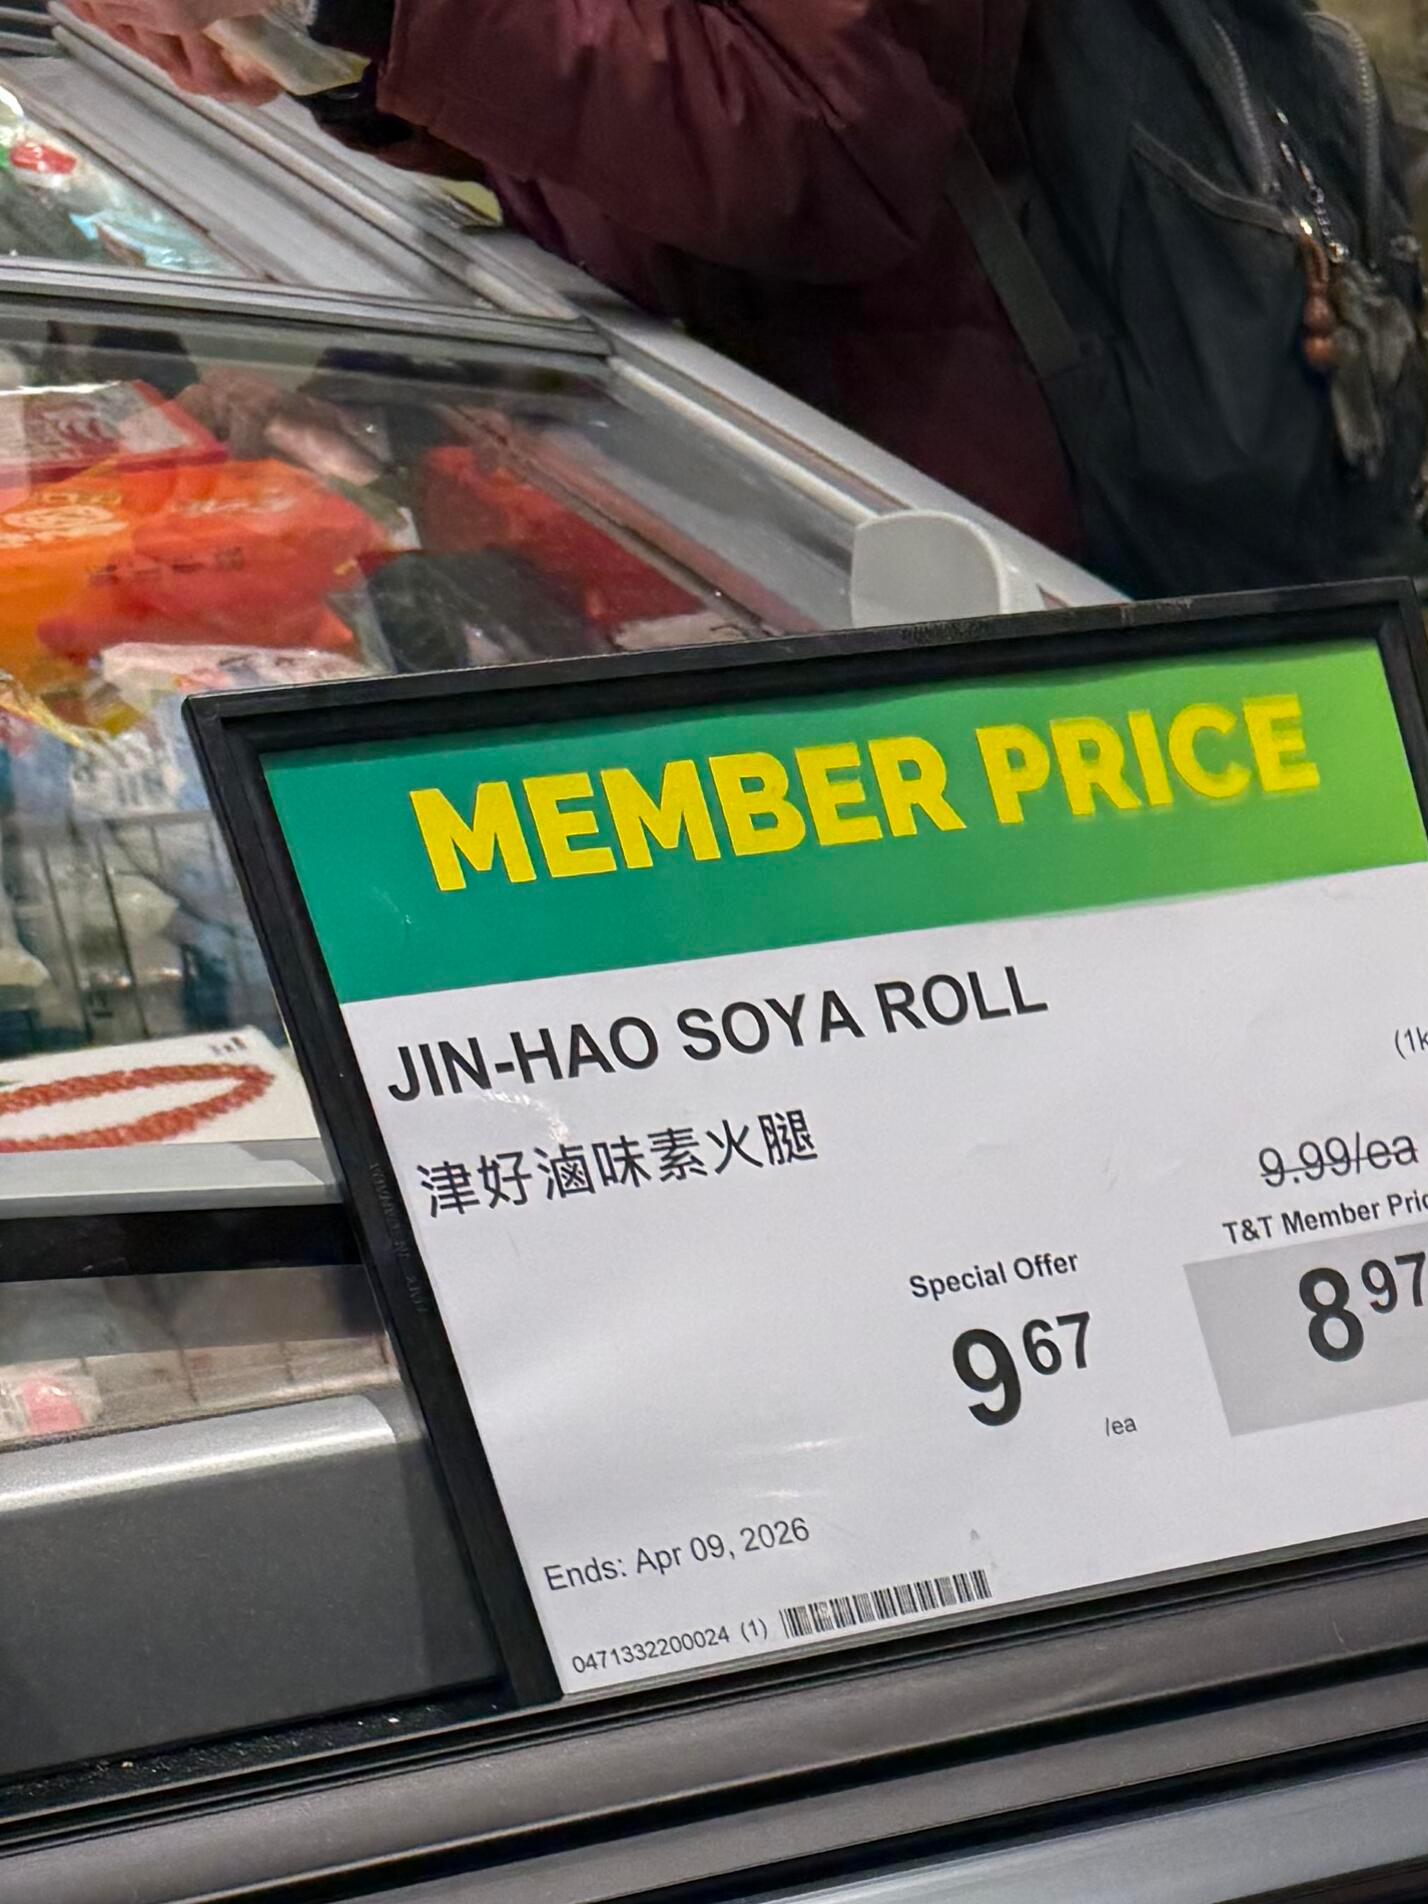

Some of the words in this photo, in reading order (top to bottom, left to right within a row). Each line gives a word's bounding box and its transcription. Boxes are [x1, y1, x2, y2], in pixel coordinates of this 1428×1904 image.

[406, 731, 968, 894] MEMBER
[972, 691, 1322, 827] PRICE
[375, 1011, 666, 1105] JIN-HAO
[671, 984, 868, 1064] SOYA
[873, 960, 1051, 1035] ROLL
[413, 1106, 822, 1220] 津好滷味素火腿
[1254, 1123, 1421, 1190] 9.99/ea
[1221, 1214, 1277, 1245] T&T
[1280, 1196, 1382, 1235] Member
[907, 1260, 1011, 1306] Special
[1010, 1247, 1082, 1282] Offer
[1102, 1412, 1139, 1438] /ea
[542, 1552, 629, 1592] Ends:
[630, 1540, 687, 1579] Apr
[687, 1531, 735, 1565] 09,
[738, 1516, 812, 1552] 2026
[570, 1624, 731, 1674] 0471332200024
[737, 1615, 770, 1643] (1)
